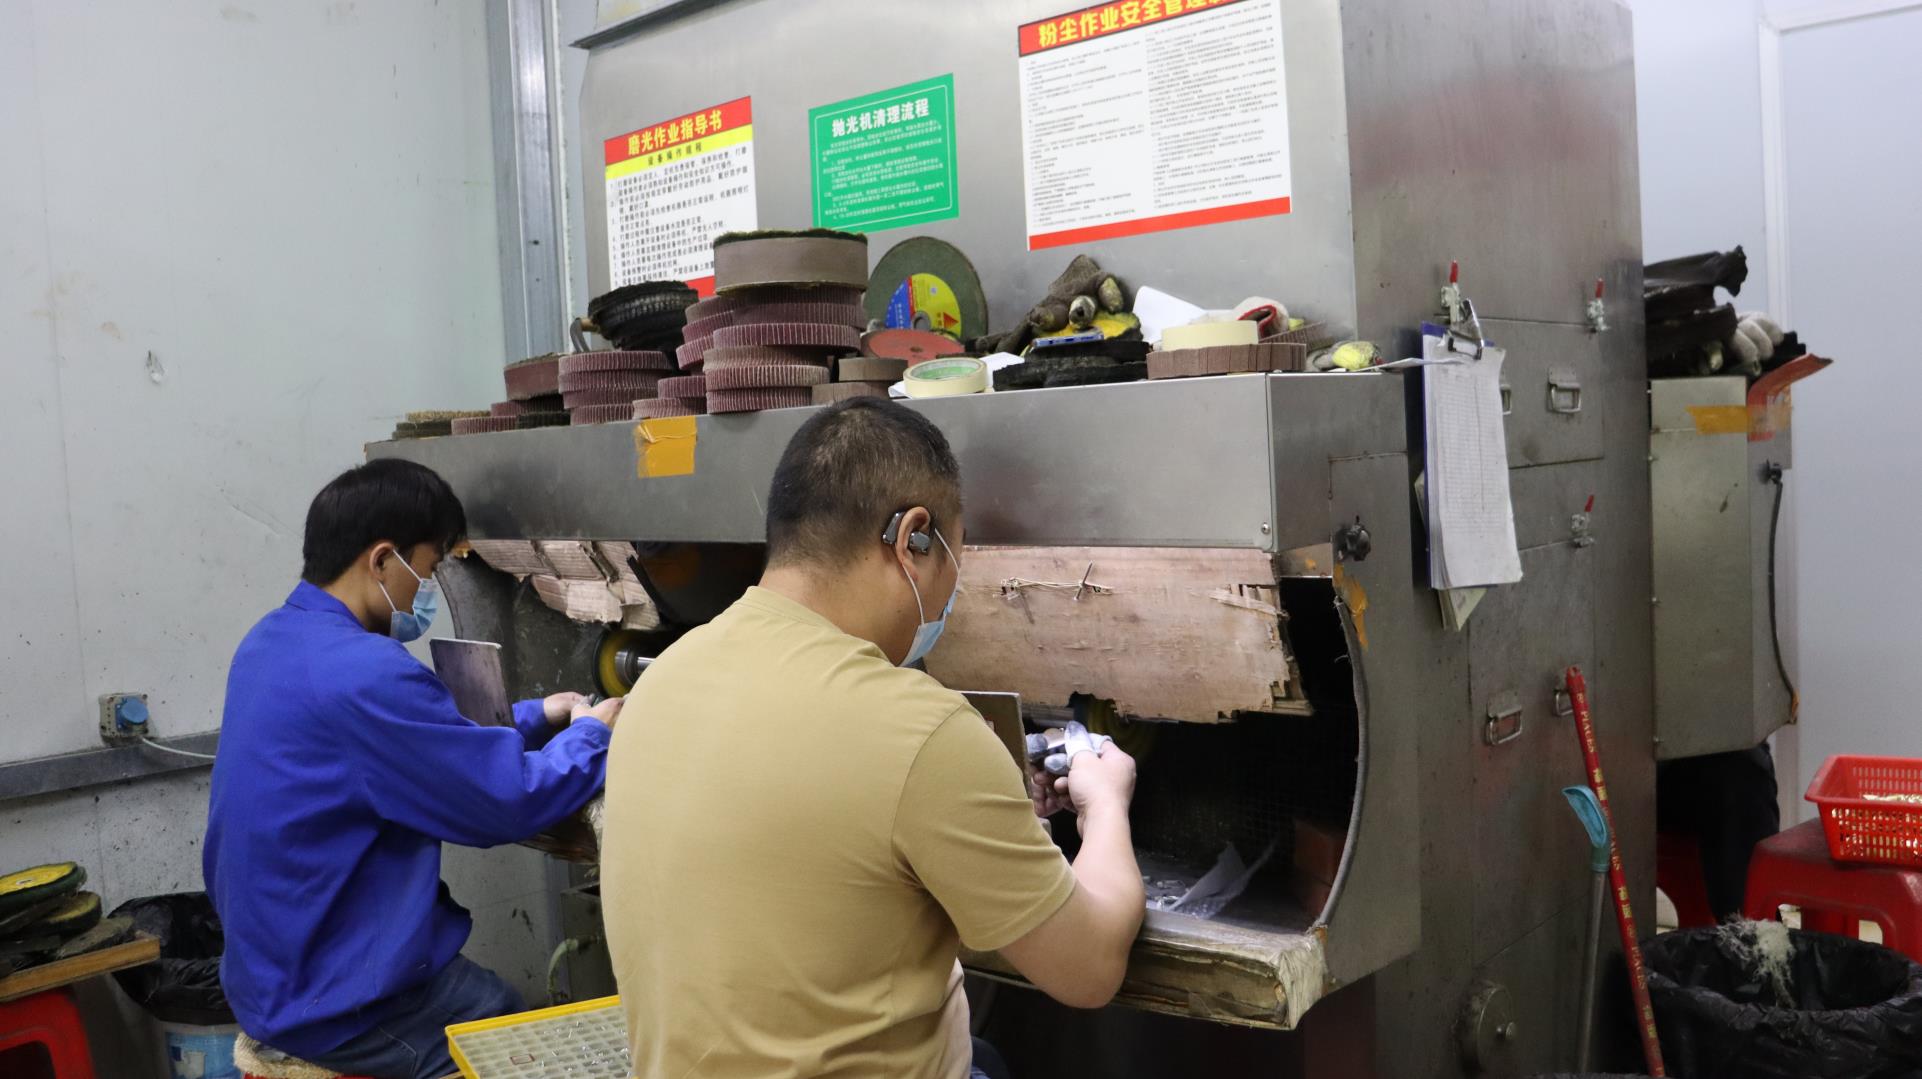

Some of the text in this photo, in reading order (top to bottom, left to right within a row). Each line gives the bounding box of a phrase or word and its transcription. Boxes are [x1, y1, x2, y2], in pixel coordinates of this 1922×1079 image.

[1038, 0, 1221, 47] 粉尘作业安全管
[628, 110, 723, 156] 磨光作业指导书
[832, 98, 929, 138] 抛光机清理流程
